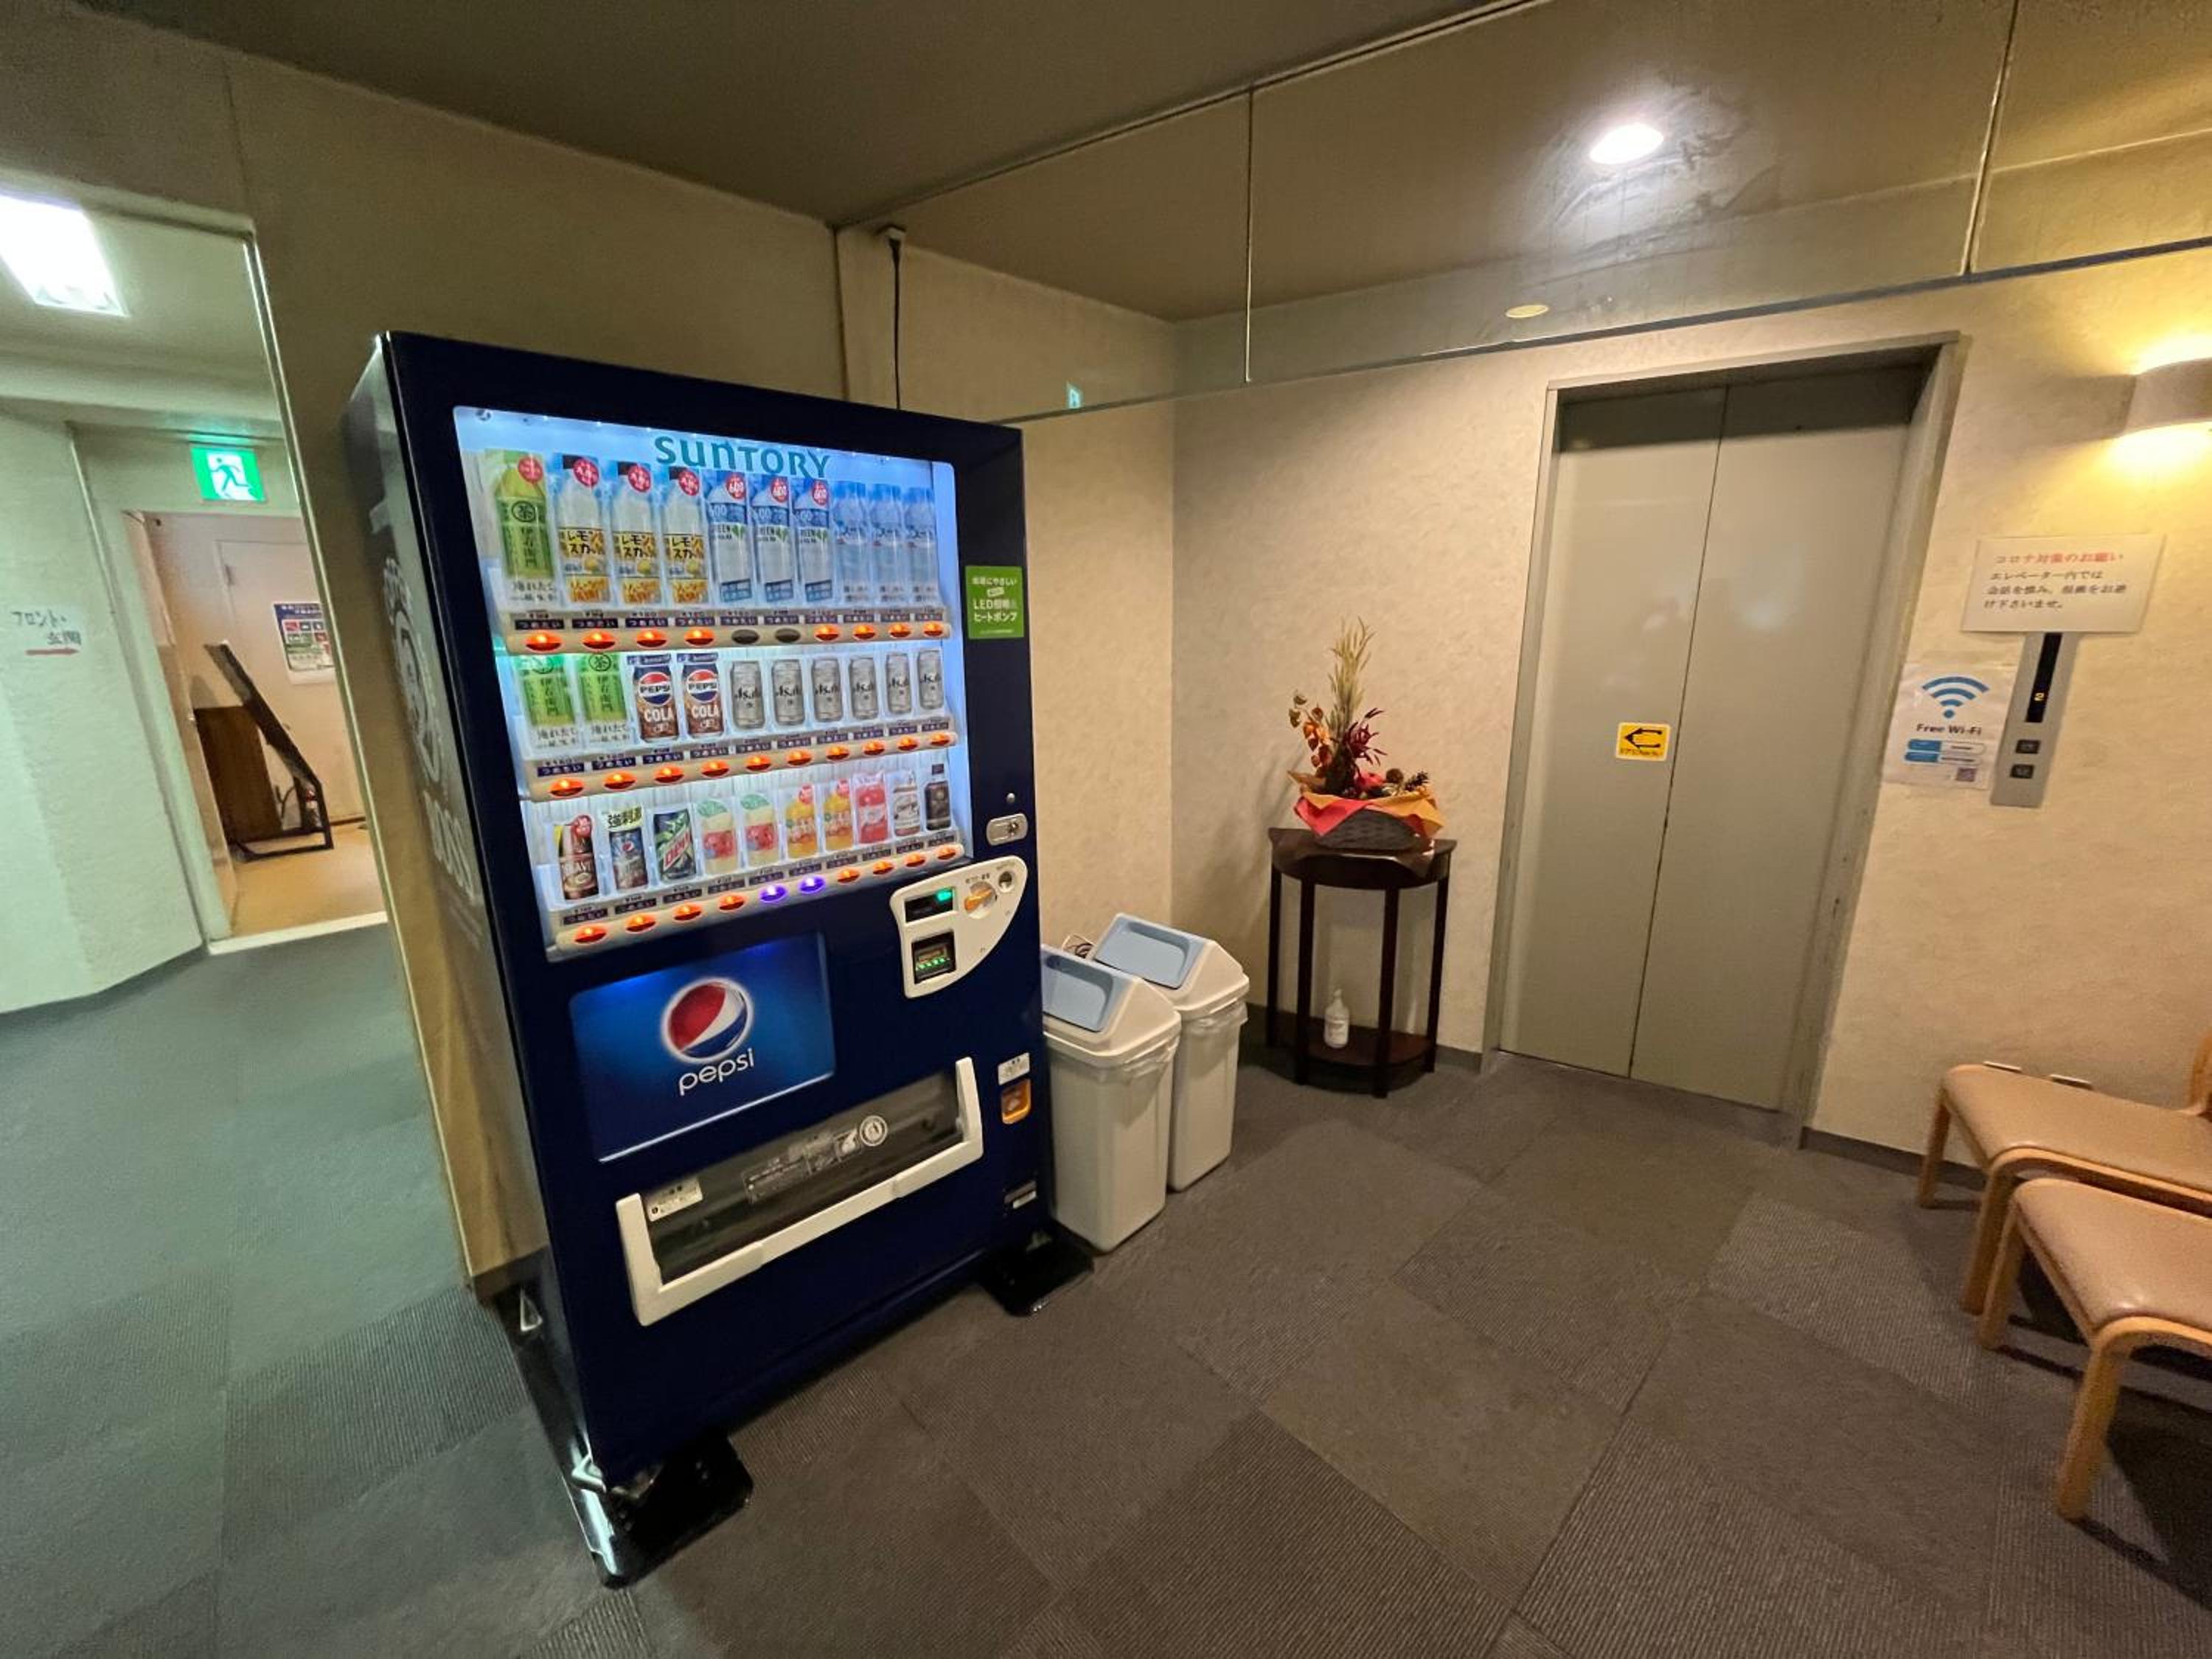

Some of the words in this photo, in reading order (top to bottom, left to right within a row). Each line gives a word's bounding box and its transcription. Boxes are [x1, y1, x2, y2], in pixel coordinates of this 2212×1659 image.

[654, 436, 830, 478] SUNTORY
[2034, 692, 2045, 701] 2
[644, 706, 675, 723] COLA
[691, 704, 720, 719] COLA
[1916, 723, 1945, 732] Free
[1948, 725, 1981, 735] Wi-Fi
[678, 1048, 754, 1096] pepsi
